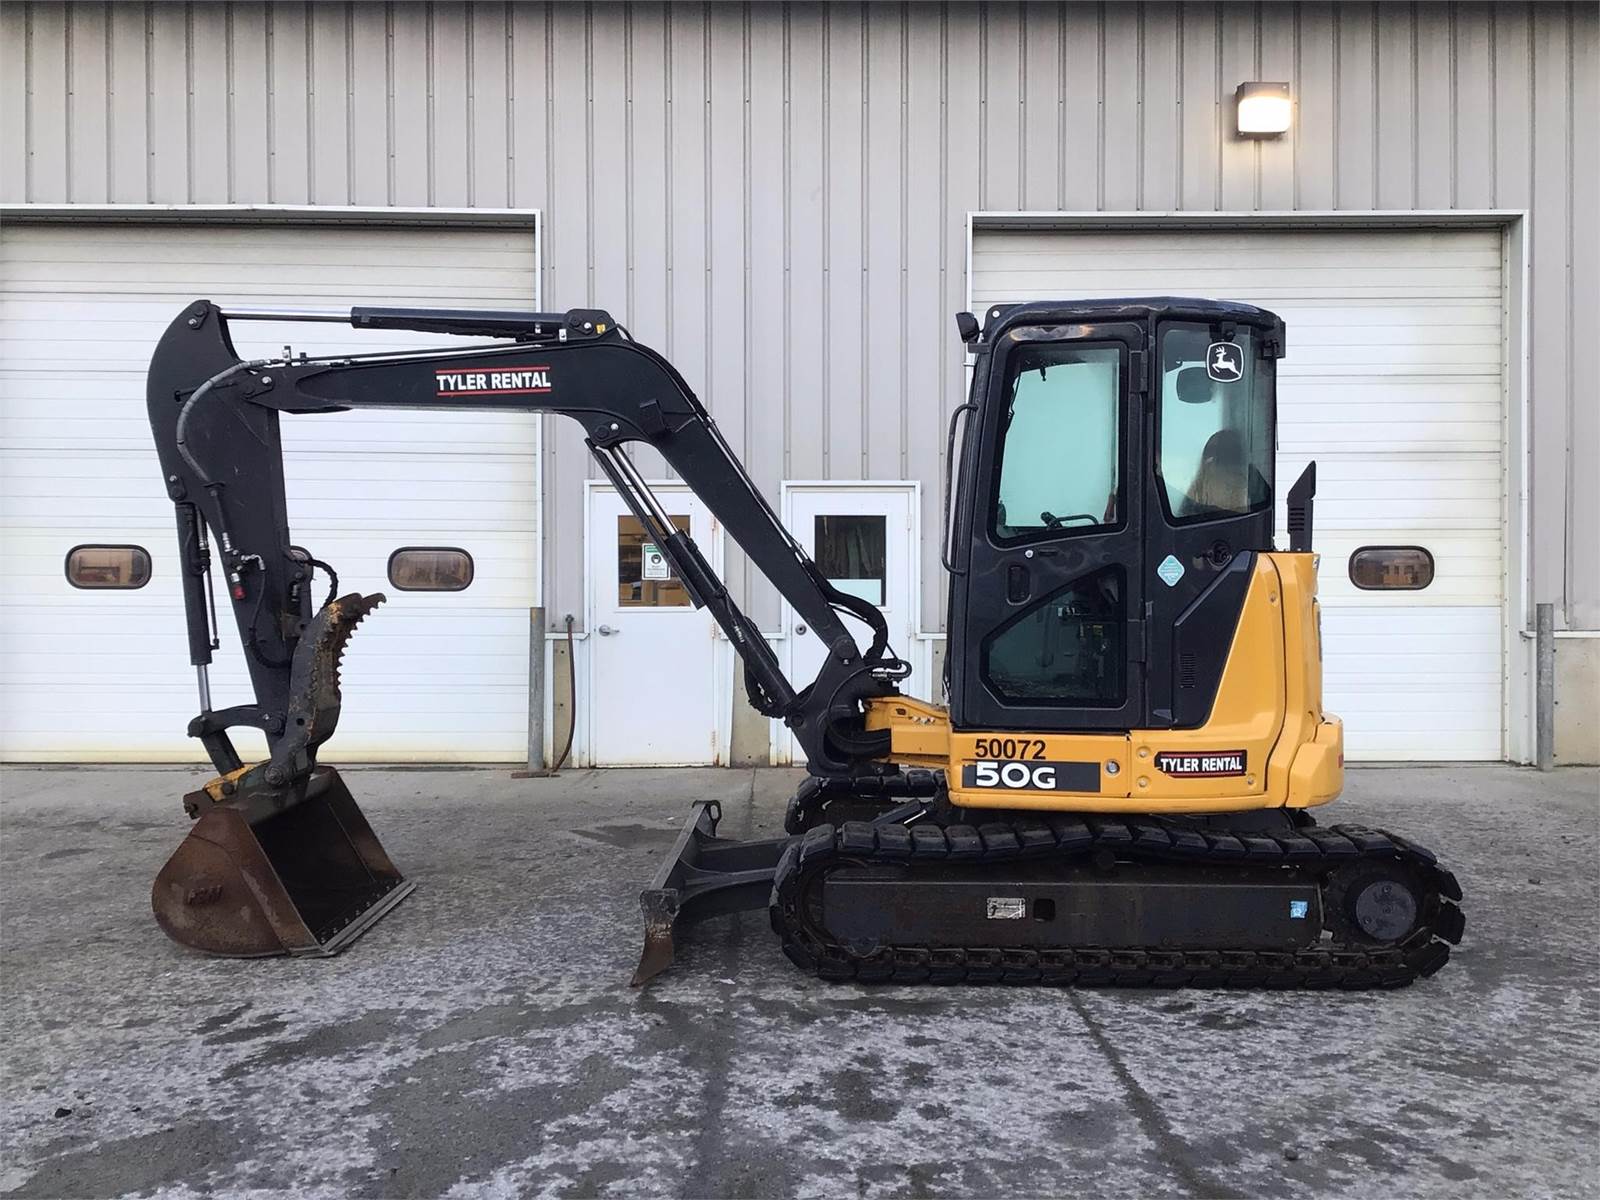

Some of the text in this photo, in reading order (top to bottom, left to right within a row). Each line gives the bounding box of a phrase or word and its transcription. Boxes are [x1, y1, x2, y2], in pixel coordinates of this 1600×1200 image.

[436, 371, 552, 391] TYLER RENTAL
[975, 738, 1046, 760] 50072
[1160, 756, 1243, 772] TYLER RENTAL
[976, 761, 1056, 789] 50G
